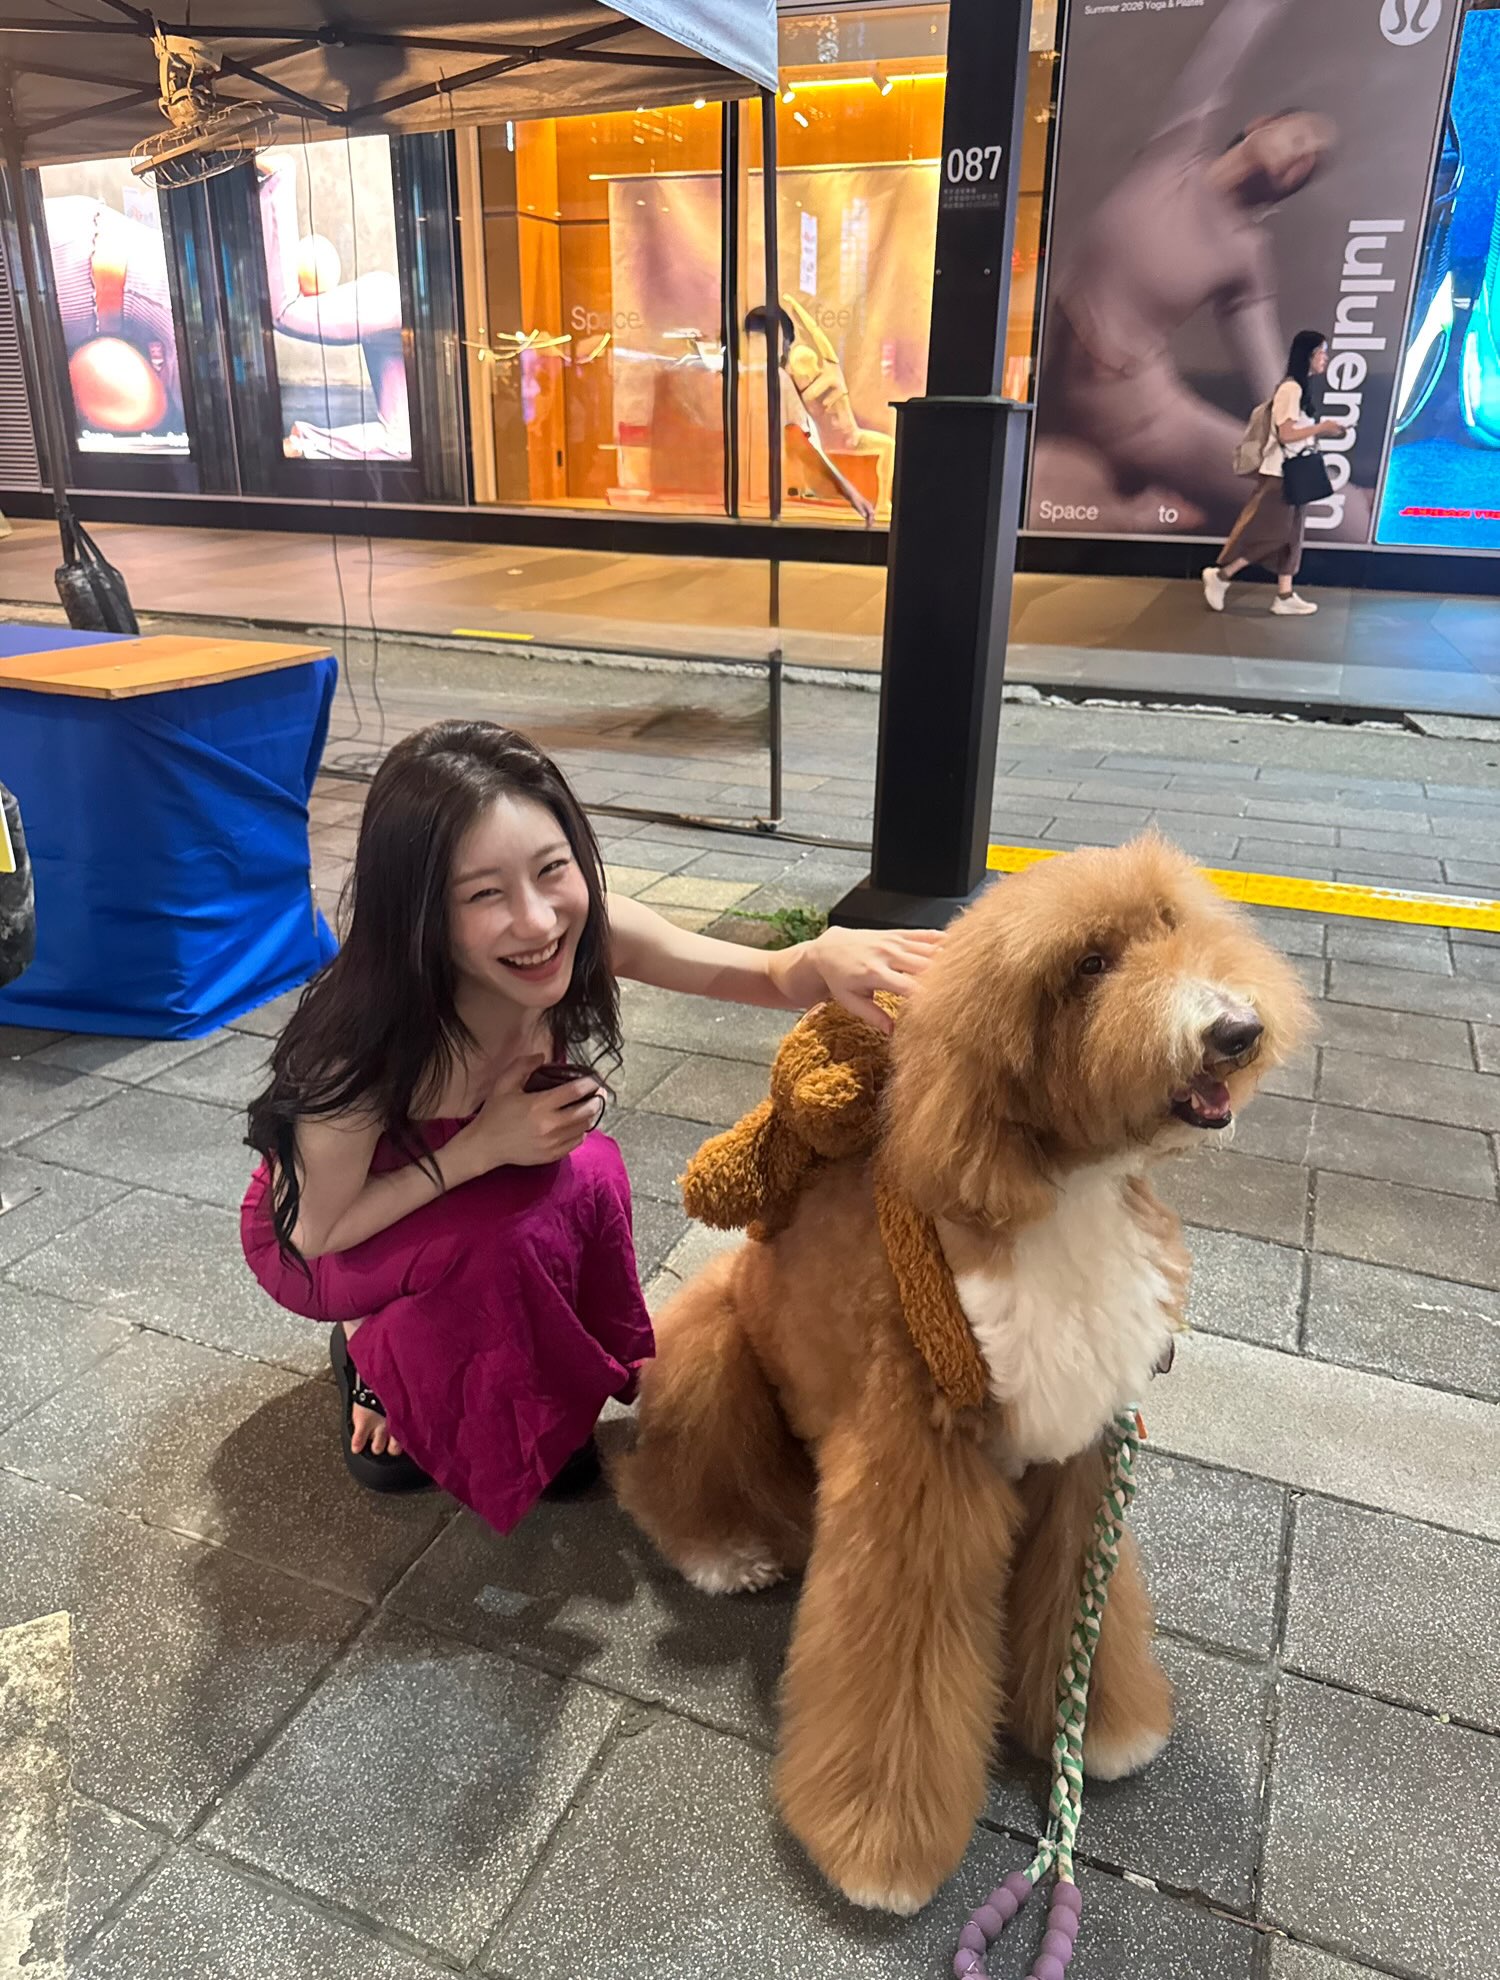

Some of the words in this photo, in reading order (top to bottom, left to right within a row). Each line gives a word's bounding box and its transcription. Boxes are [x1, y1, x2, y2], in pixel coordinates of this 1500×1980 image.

[1085, 5, 1120, 15] Summer
[1145, 1, 1167, 11] Yoga
[1167, 0, 1175, 8] &
[947, 145, 1002, 183] 087
[1039, 501, 1099, 523] Space
[1158, 505, 1179, 523] to
